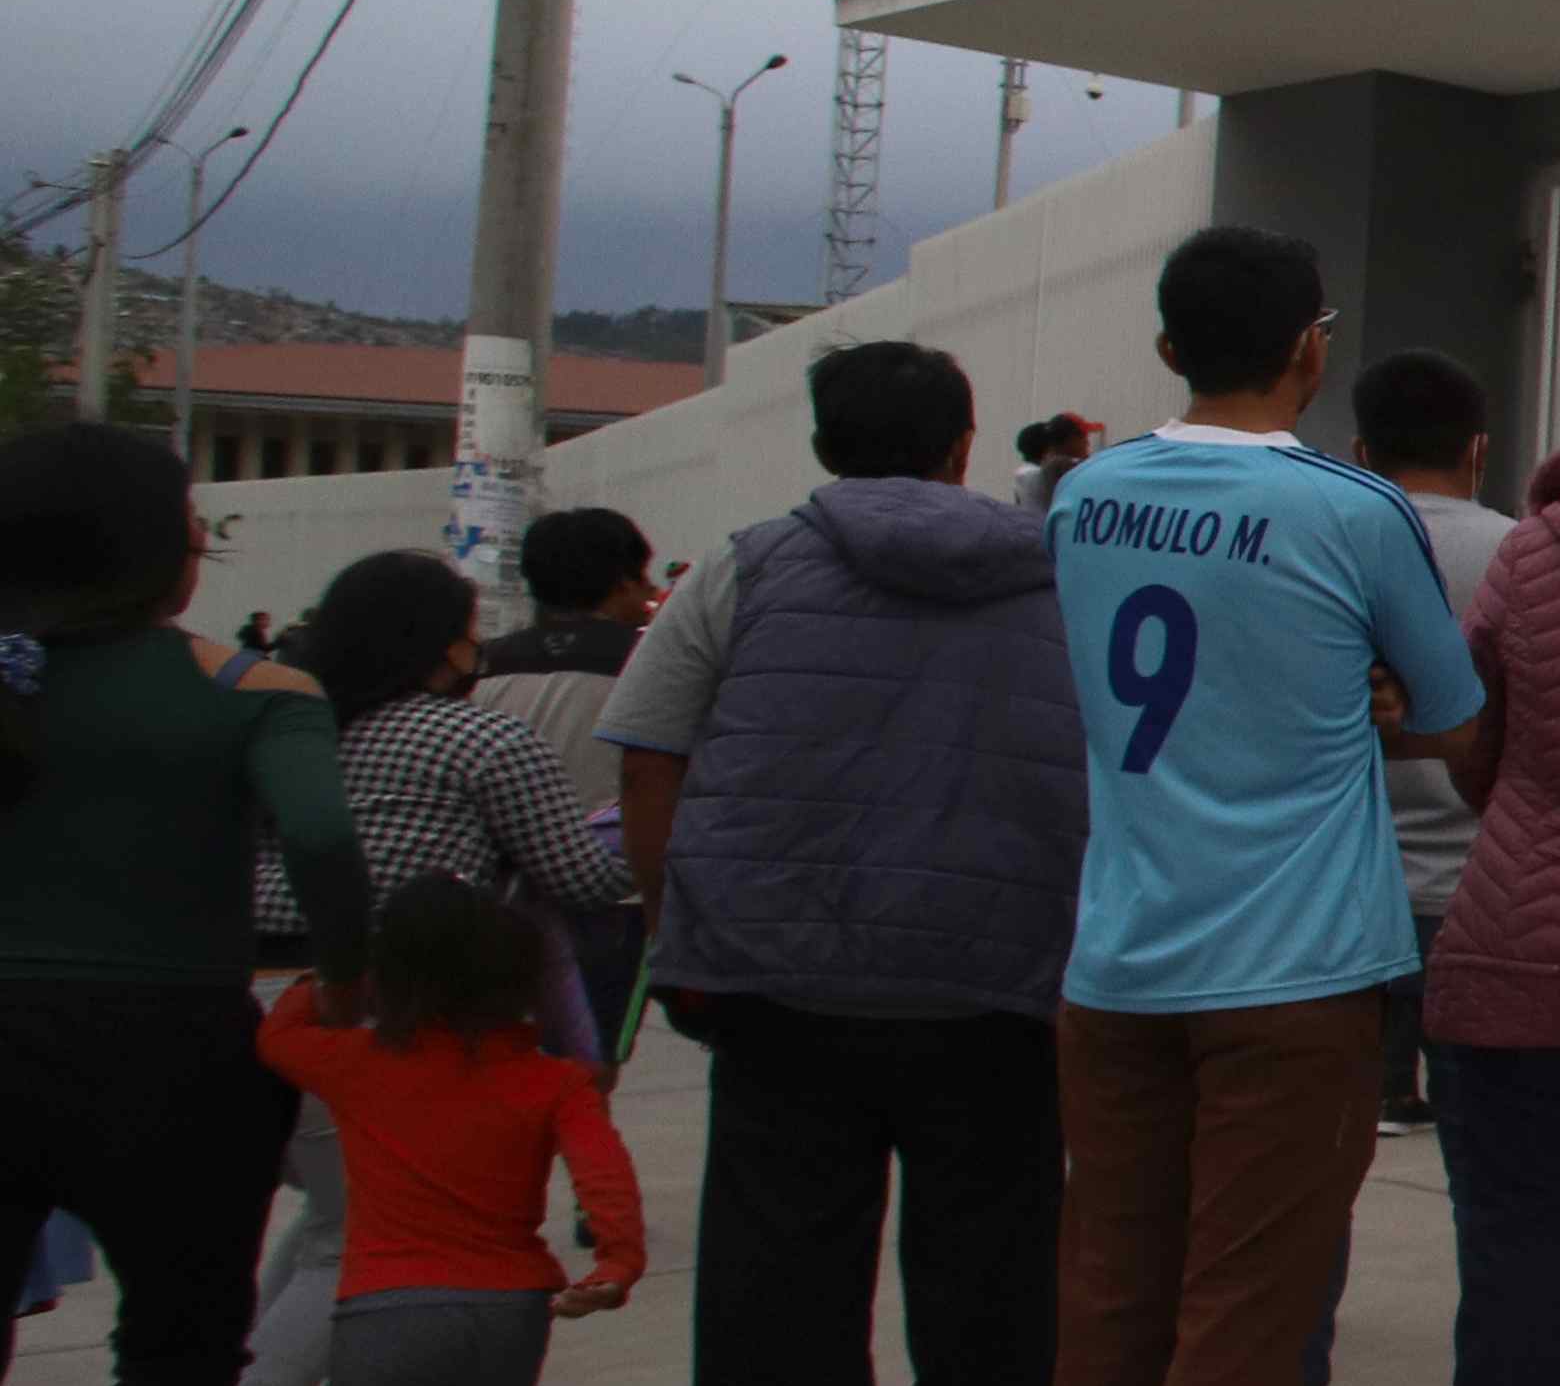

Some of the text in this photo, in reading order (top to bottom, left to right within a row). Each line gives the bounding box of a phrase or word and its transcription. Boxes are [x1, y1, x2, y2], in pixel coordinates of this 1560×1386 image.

[1072, 497, 1272, 566] ROMULO M.
[1106, 583, 1199, 776] 9
